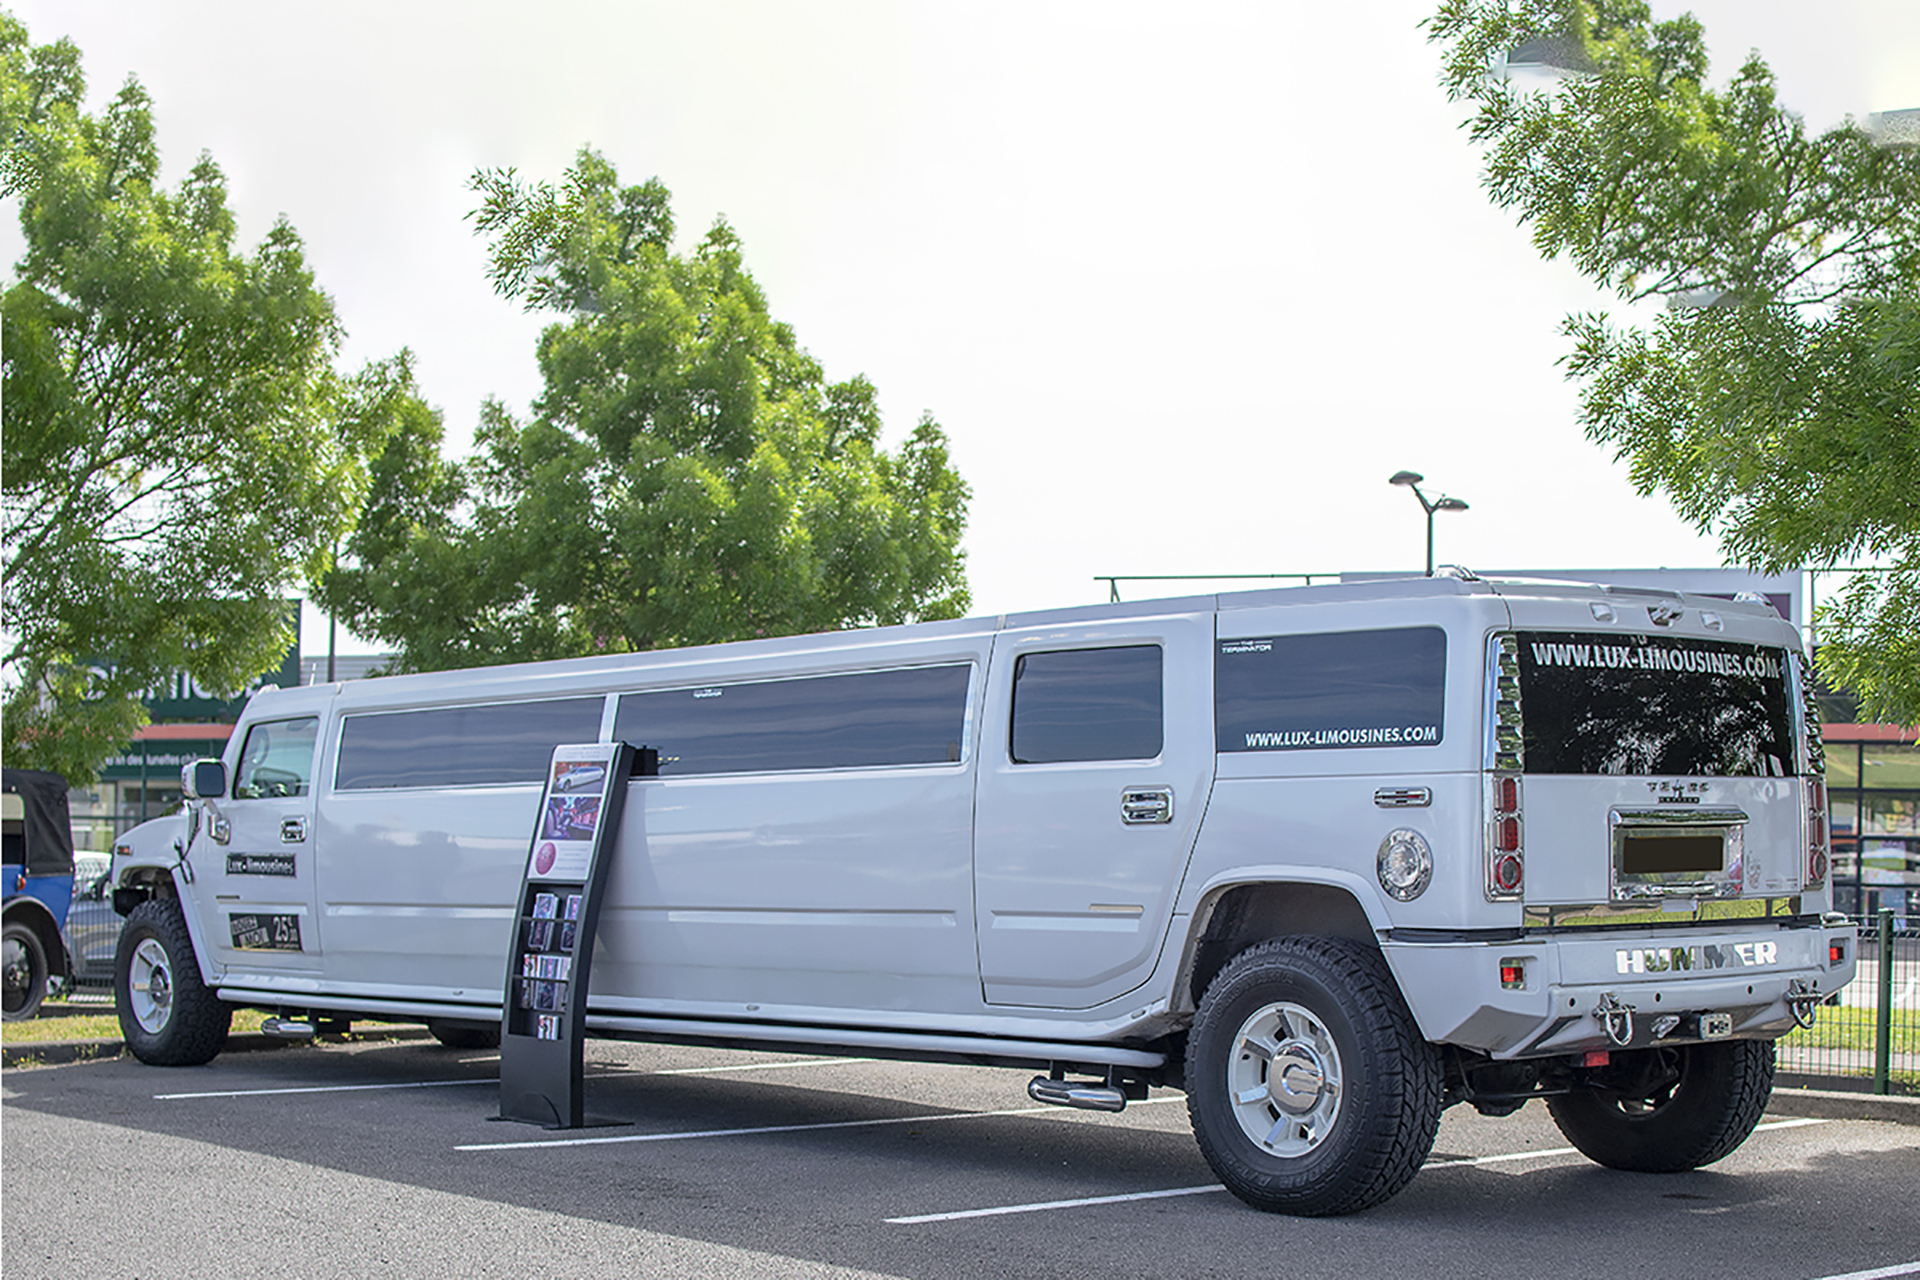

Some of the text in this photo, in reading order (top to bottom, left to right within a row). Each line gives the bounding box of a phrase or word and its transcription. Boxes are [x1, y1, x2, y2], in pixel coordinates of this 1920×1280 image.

[1531, 643, 1780, 679] WWW.LUX-LIMOUSINES.COM
[1245, 726, 1437, 747] WWW.LUX-LIMOUSINES.COM
[1616, 941, 1777, 974] HUMMER
